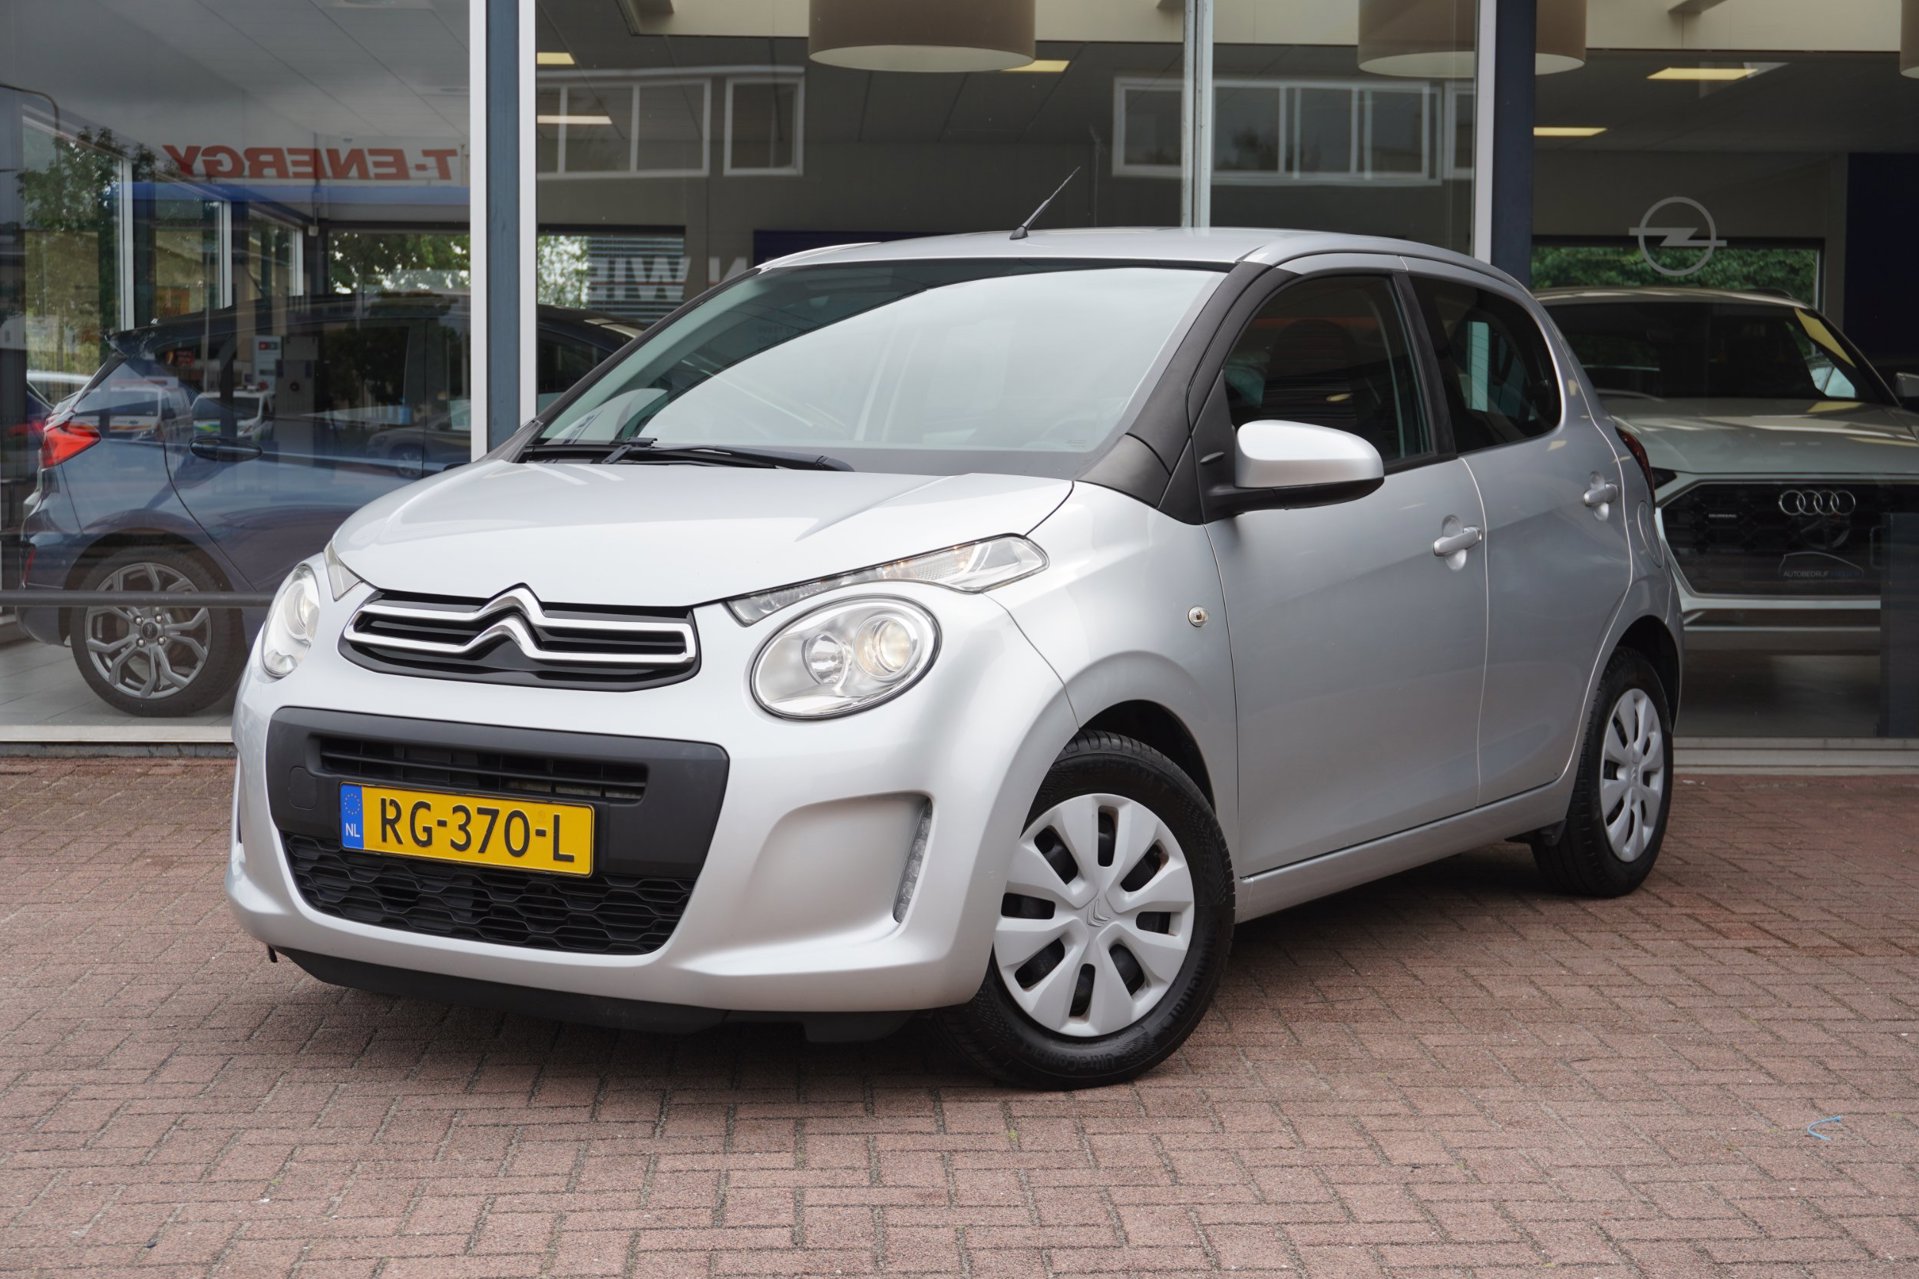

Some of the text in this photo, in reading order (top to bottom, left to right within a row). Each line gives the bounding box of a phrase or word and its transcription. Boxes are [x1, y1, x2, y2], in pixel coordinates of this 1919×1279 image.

[345, 797, 575, 863] NL RG-370-L
[1166, 916, 1219, 1027] ontinental
